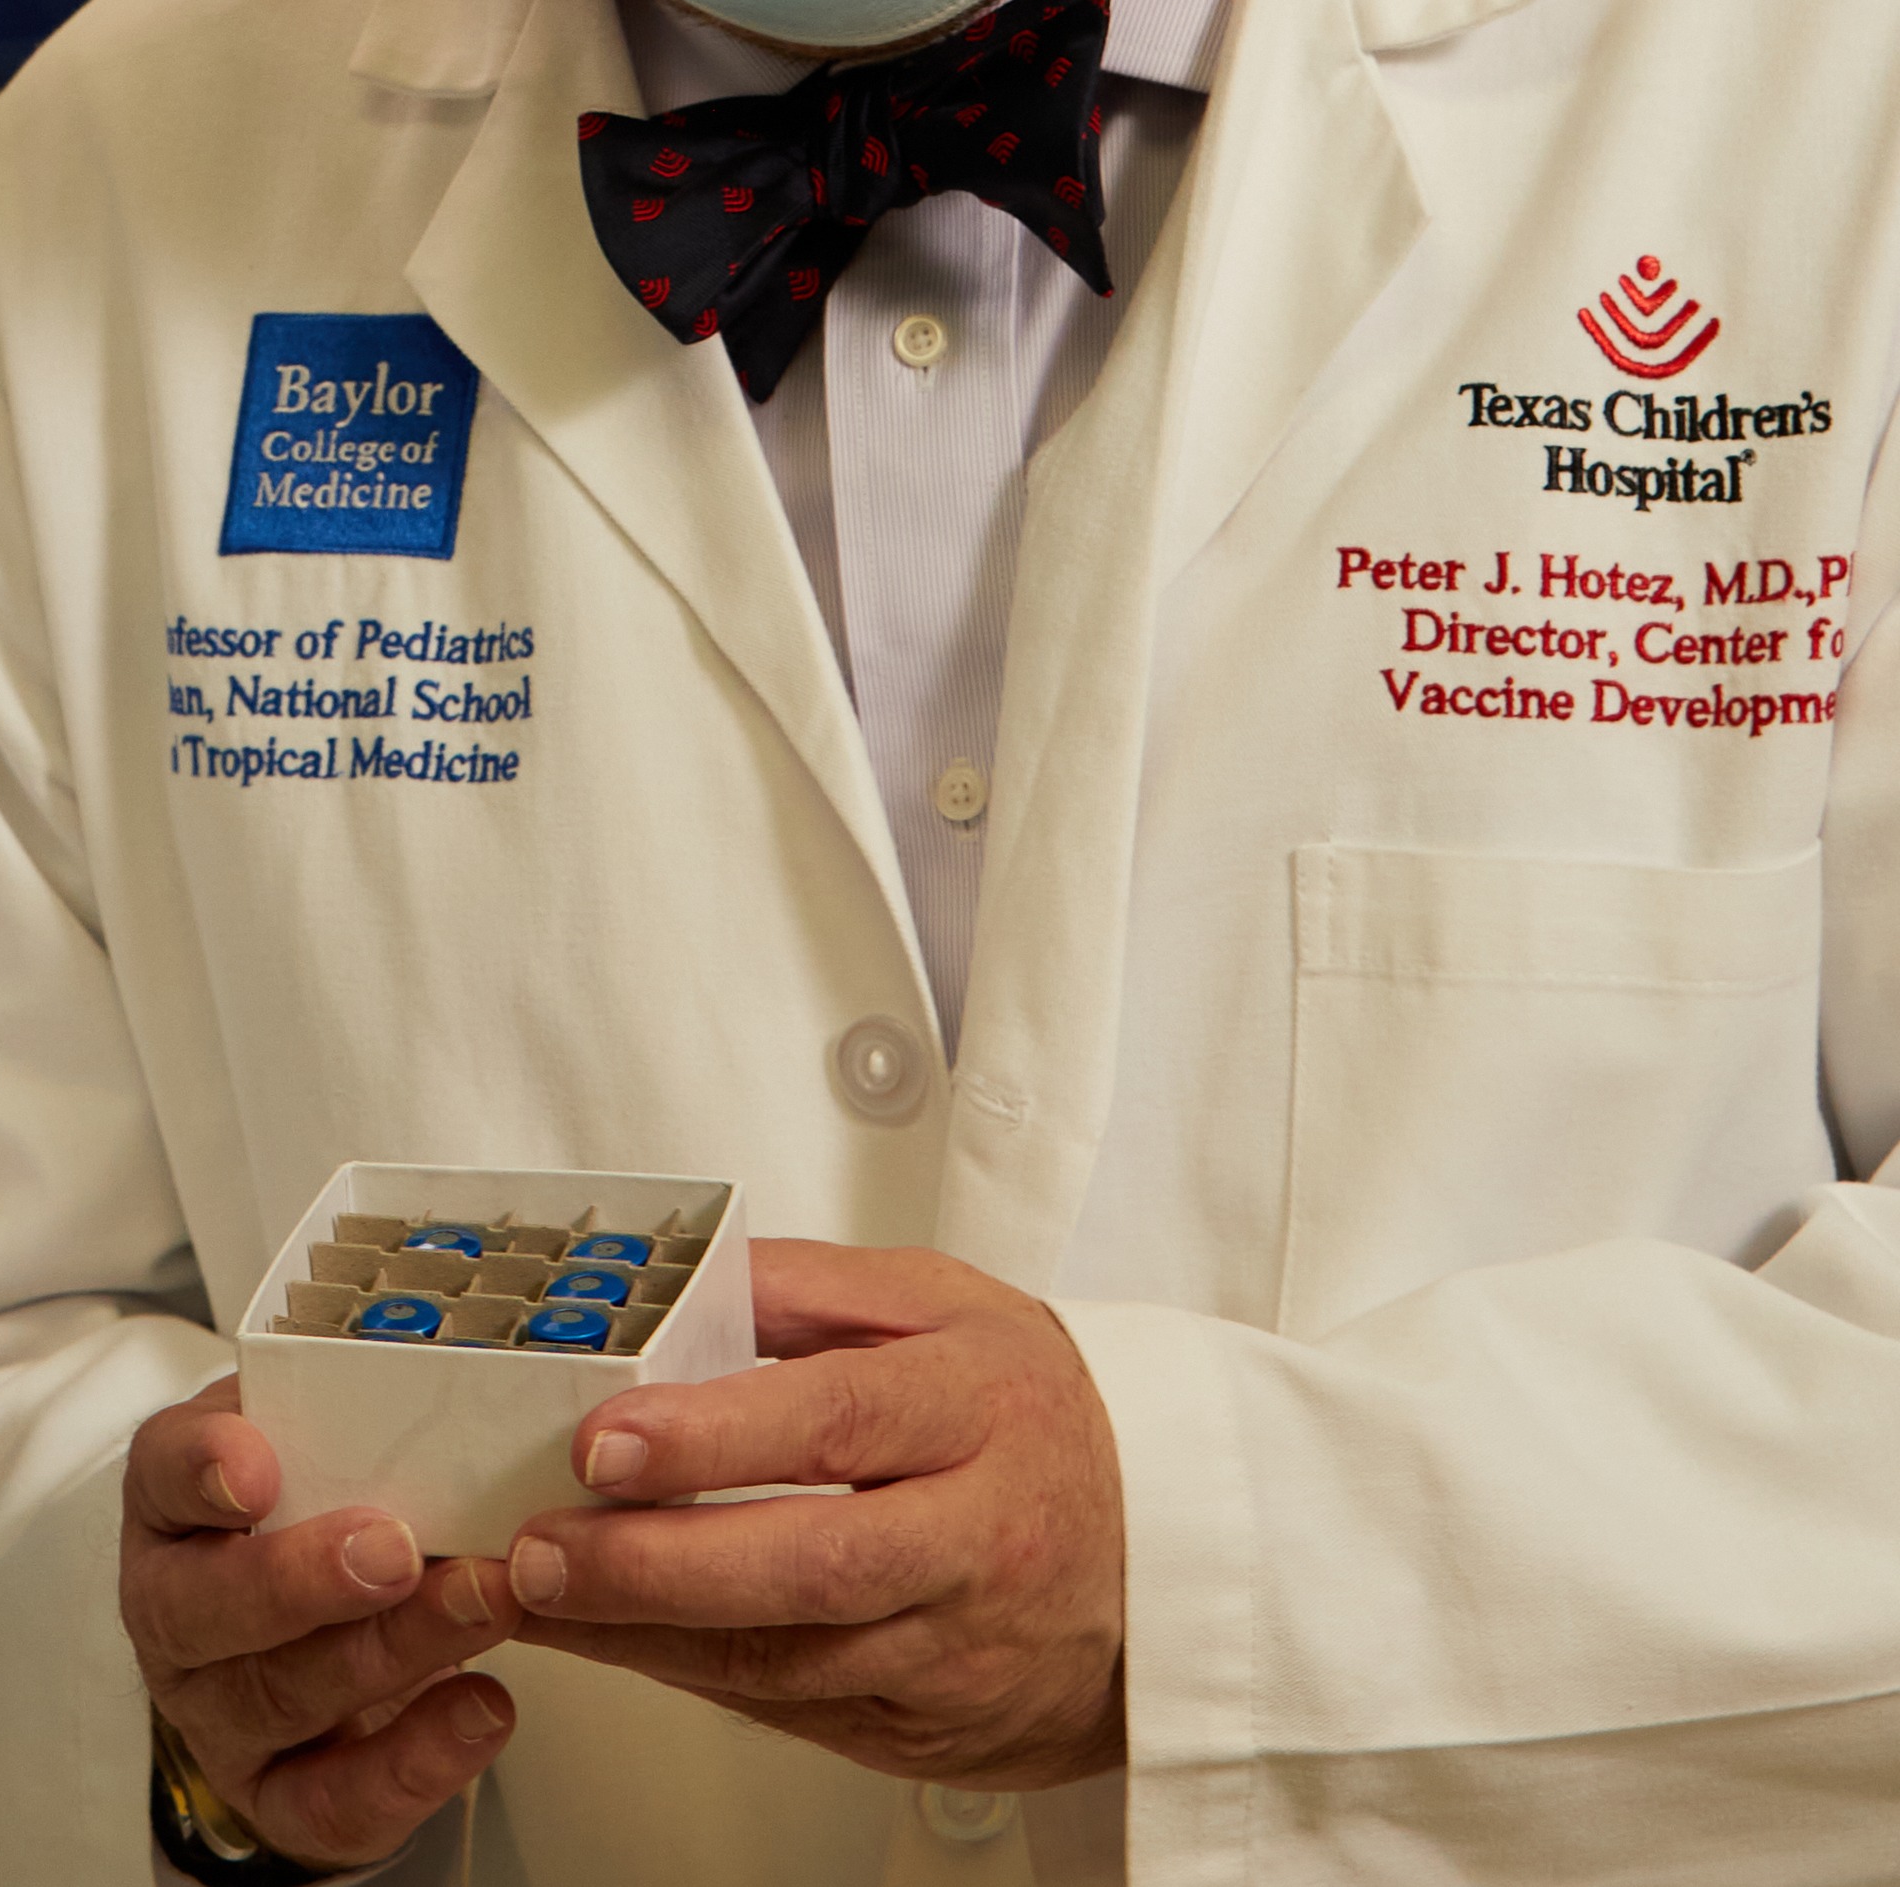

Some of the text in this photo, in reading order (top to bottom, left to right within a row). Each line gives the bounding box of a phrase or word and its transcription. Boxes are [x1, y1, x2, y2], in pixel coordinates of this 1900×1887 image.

[272, 361, 444, 427] Baylor
[1458, 382, 1833, 442] Texas Children's
[261, 429, 440, 471] College of
[252, 472, 433, 510] Medicine
[1336, 546, 1466, 591] Peter
[1483, 552, 1522, 596] J.
[1539, 552, 1686, 612] Hotez,
[294, 619, 344, 661] of
[355, 619, 535, 665] Pediatrics
[1400, 607, 1845, 667] Director, Center fo
[227, 674, 397, 720] National
[411, 675, 533, 724] School
[1380, 668, 1837, 739] Vaccine Developme
[182, 733, 339, 788] Tropical
[349, 735, 521, 784] Medicine
